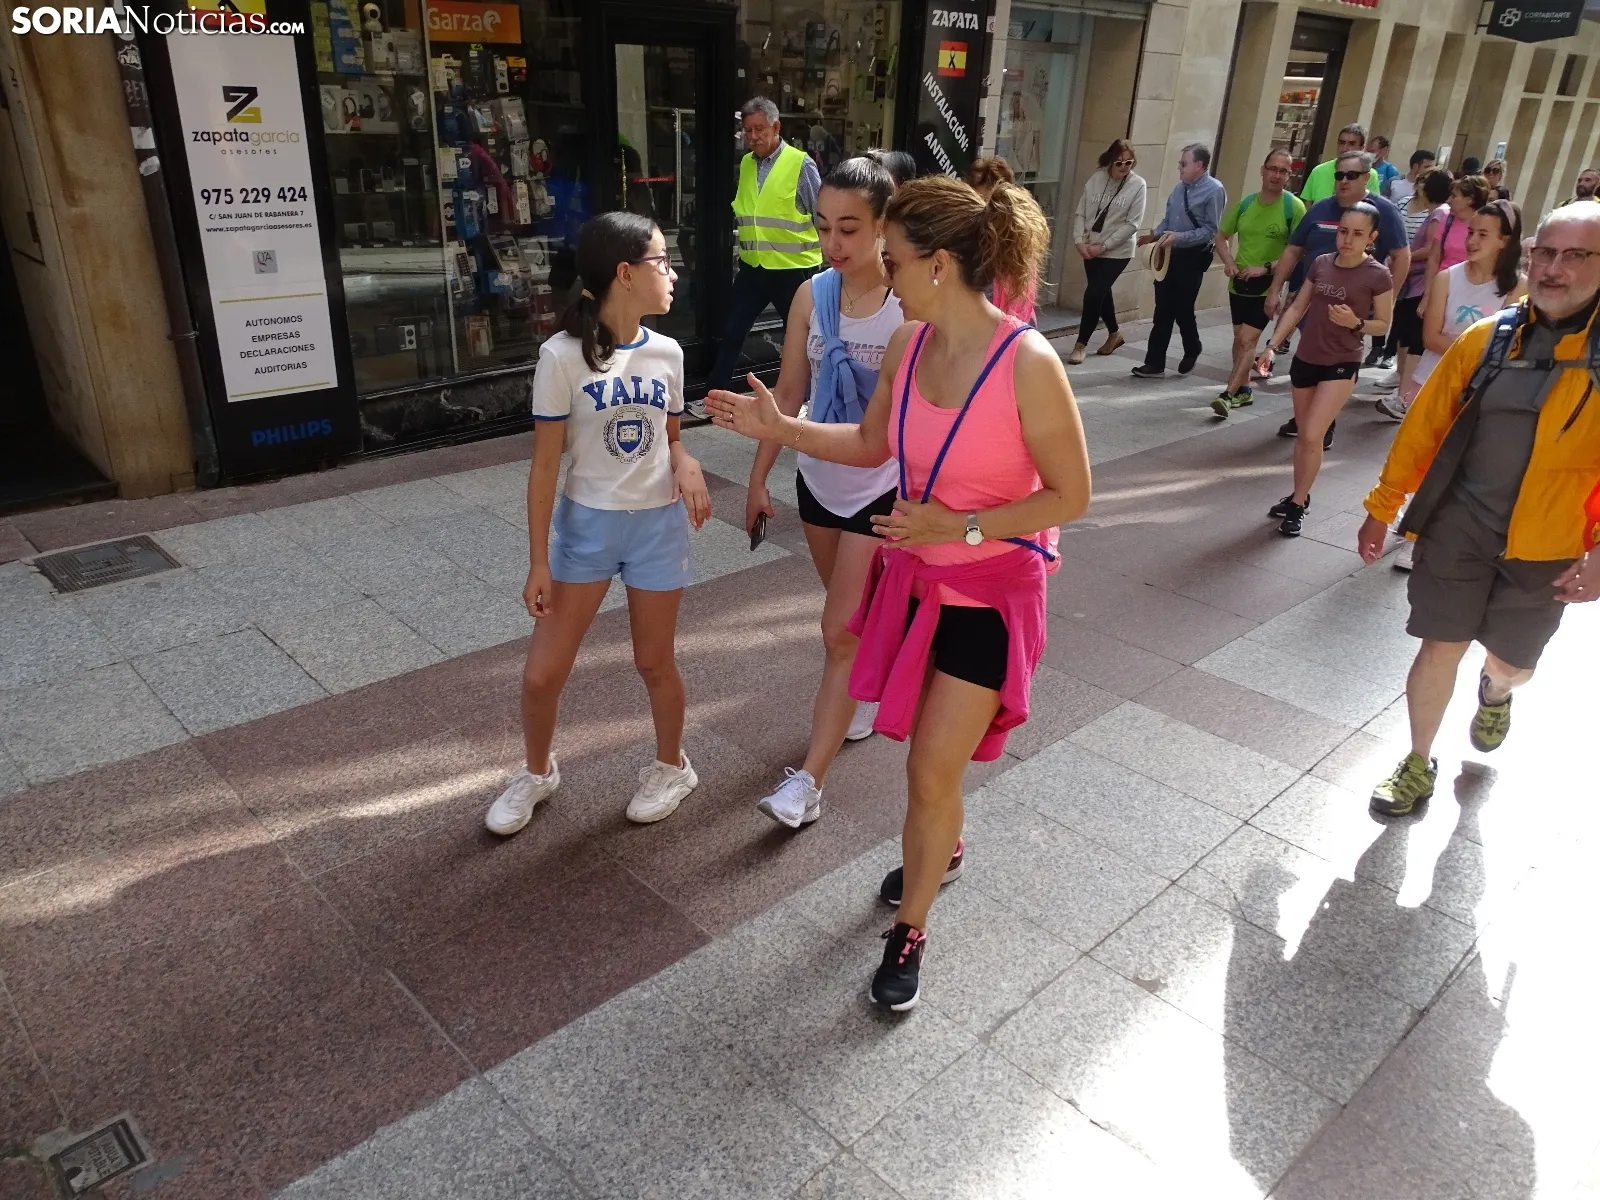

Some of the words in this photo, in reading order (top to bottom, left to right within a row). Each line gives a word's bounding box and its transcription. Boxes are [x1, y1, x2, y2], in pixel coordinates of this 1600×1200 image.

[427, 8, 483, 31] Garza
[932, 9, 979, 30] ZAPATA
[923, 72, 969, 152] INSTALACIÓN:
[201, 189, 234, 205] 975
[239, 188, 271, 204] 229
[277, 186, 308, 202] 424
[218, 212, 233, 220] SAN
[234, 211, 253, 219] JUAN
[265, 210, 299, 218] RABANERA
[1316, 282, 1347, 300] FILA
[245, 314, 304, 328] AUTONOMOS
[251, 330, 301, 343] EMPRESAS
[239, 343, 316, 359] DECLARACIONES
[254, 361, 308, 375] AUDITORIAS
[582, 375, 667, 411] YALE
[251, 419, 332, 446] PHILIPS
